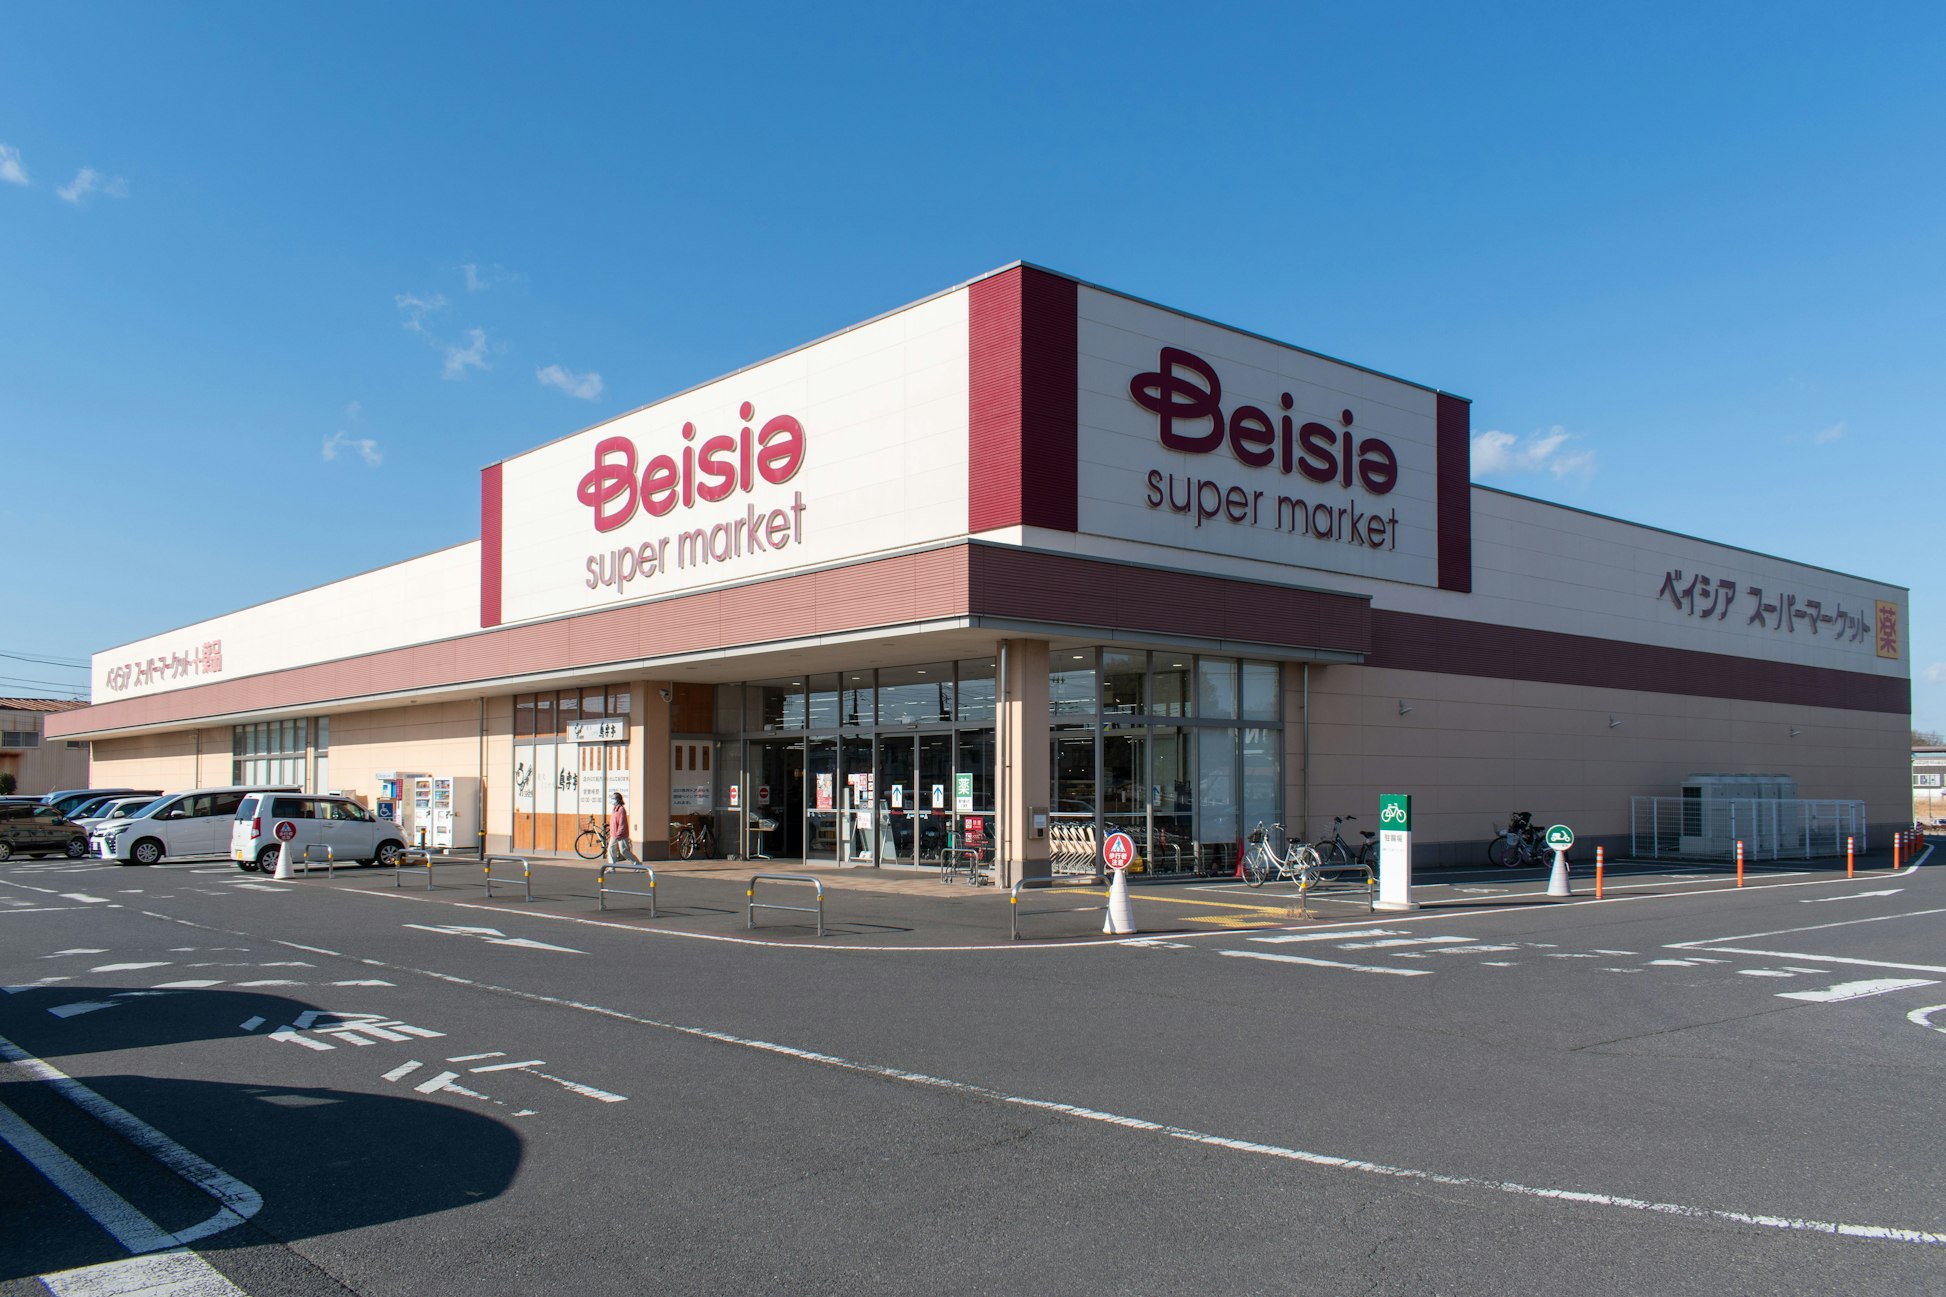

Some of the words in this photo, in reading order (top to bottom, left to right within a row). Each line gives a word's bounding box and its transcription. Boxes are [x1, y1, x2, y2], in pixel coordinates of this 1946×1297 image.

[1129, 346, 1398, 495] Beisia
[577, 401, 806, 533] Beisia
[1146, 469, 1264, 529] super
[1275, 499, 1399, 550] market
[586, 536, 670, 594] super
[678, 491, 806, 569] market
[1879, 606, 1897, 653] 薬
[958, 777, 970, 795] 薬
